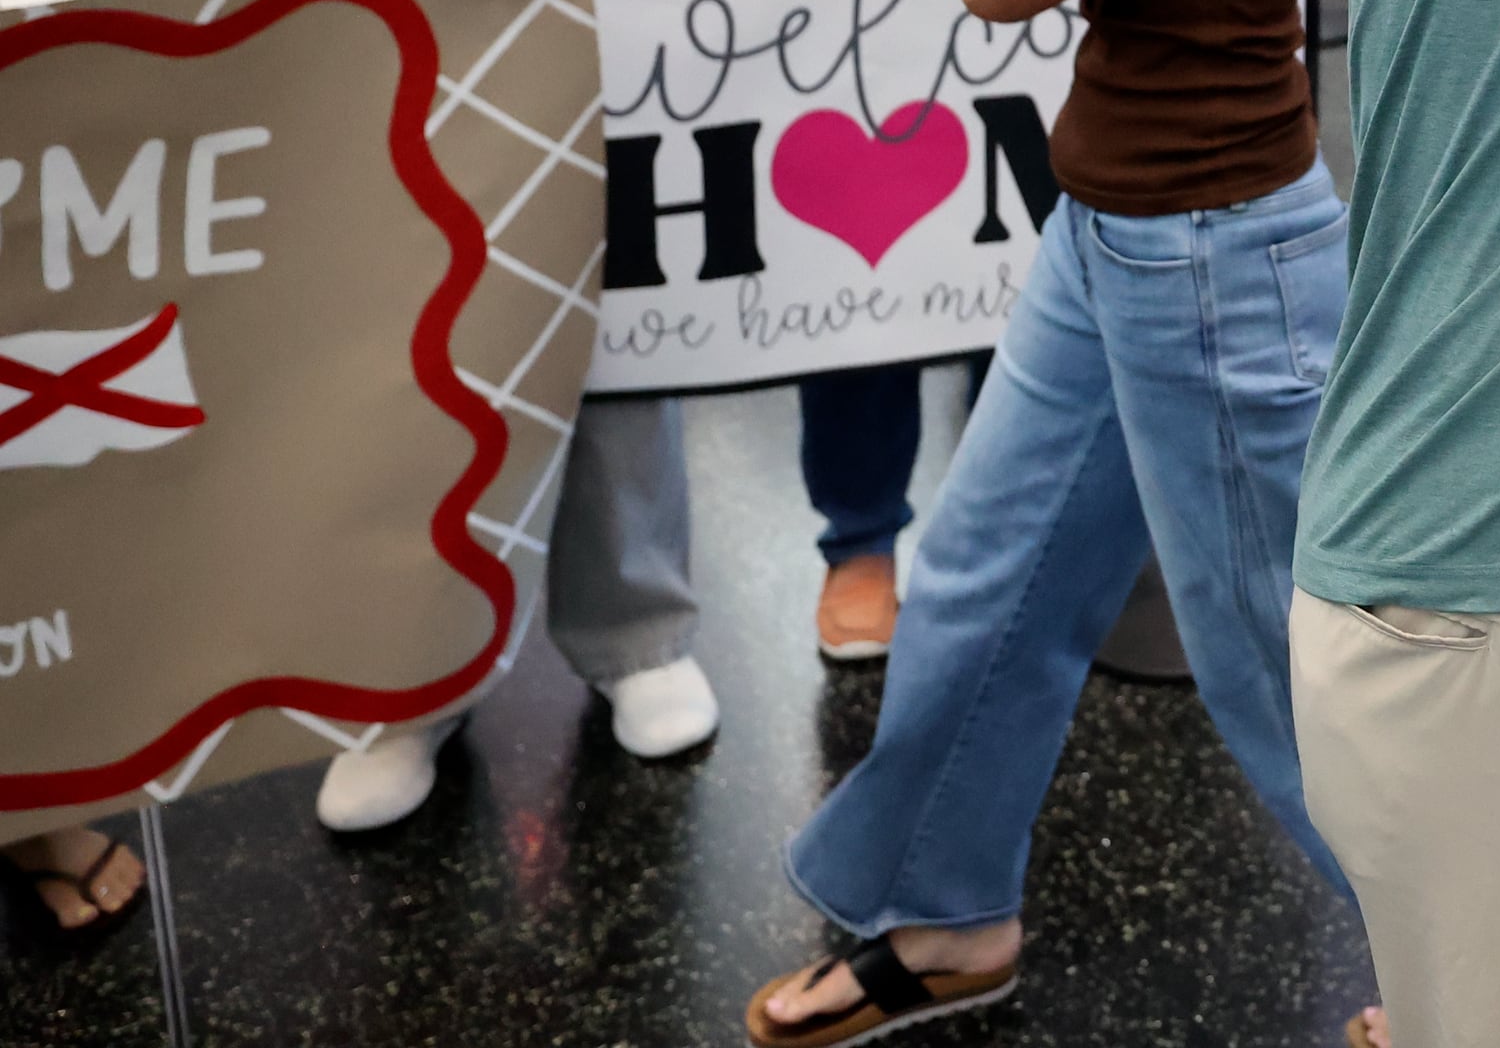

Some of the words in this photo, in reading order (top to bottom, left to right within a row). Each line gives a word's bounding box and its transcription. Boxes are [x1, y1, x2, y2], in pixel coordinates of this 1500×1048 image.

[0, 125, 272, 292] ME
[602, 306, 715, 356] we
[737, 272, 903, 349] have
